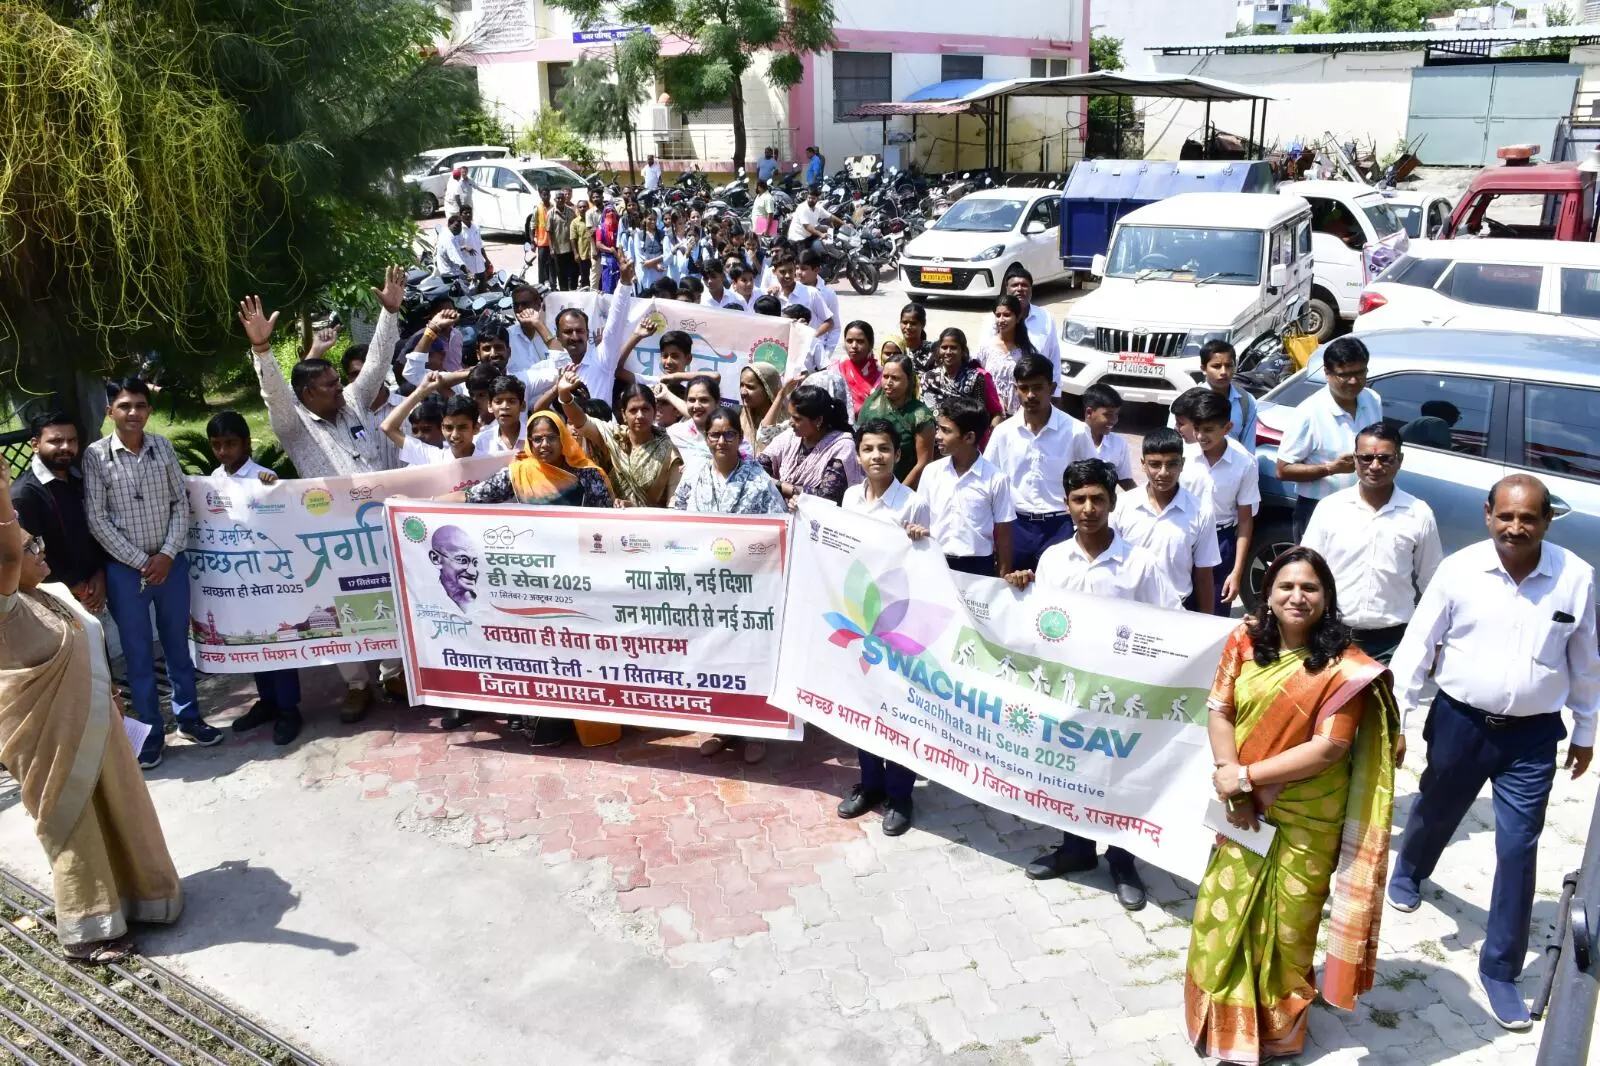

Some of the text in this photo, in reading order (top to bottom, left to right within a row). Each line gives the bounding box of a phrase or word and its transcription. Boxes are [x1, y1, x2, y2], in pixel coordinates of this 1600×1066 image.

[484, 552, 556, 568] स्वच्छता
[202, 582, 303, 599] स्वच्छता ही सेवा 2025
[356, 577, 379, 587] सितंबर
[486, 568, 592, 592] ही सेवा 2025
[625, 566, 753, 595] नया जोश, नई दिशा
[612, 602, 774, 631] जन भागीदारी से नई ऊर्जा
[228, 648, 260, 663] भारत
[262, 647, 297, 661] मिशन
[310, 640, 352, 657] ग्रामीण
[363, 637, 398, 651] जिला
[481, 625, 688, 658] स्वच्छता ही सेवा का शुभारम्भ
[442, 648, 492, 670] विशाल
[495, 656, 548, 674] स्वच्छता
[551, 656, 582, 678] रैली
[599, 666, 619, 681] 17
[697, 672, 747, 691] 2025
[479, 674, 713, 712] जिला प्रशासन, राजसमन्द
[908, 687, 1076, 772] Swachhata Hi Seva 2025
[880, 702, 1105, 798] A Swachh Bharat Mission Initiative
[796, 686, 834, 715] स्वच्छ
[838, 704, 871, 732] भारत
[874, 716, 910, 751] मिशन
[923, 743, 970, 777] ग्रामीण
[982, 767, 1021, 801] जिला
[1024, 790, 1080, 822] परिषद,
[1084, 806, 1163, 848] राजसमन्द
